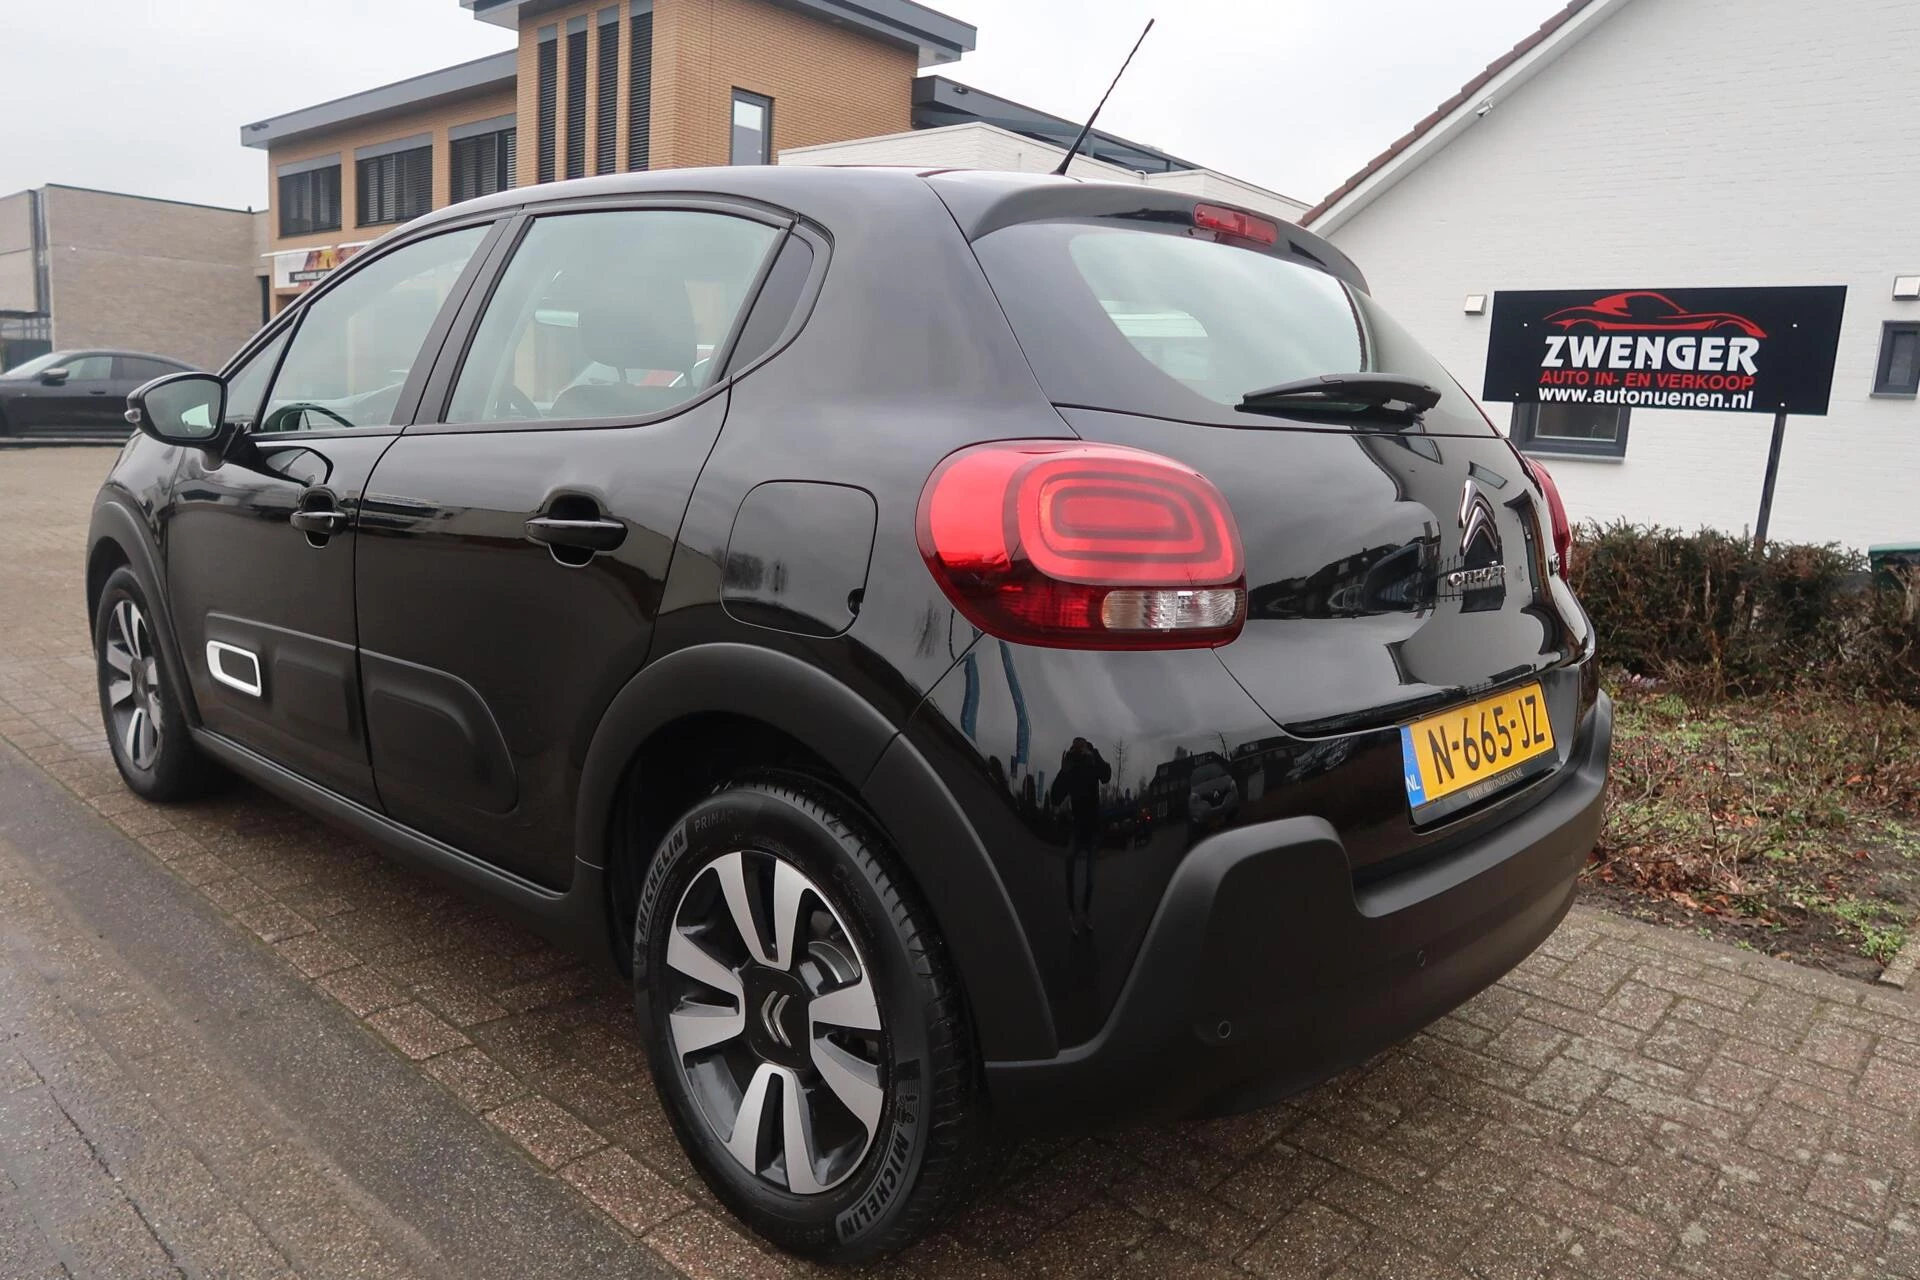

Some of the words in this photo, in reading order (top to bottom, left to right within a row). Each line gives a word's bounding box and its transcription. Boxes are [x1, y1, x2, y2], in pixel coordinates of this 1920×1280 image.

[1541, 336, 1760, 376] ZWENGER
[1541, 372, 1589, 386] AUTO
[1594, 373, 1619, 386] IN-
[1625, 374, 1650, 388] EN
[1657, 373, 1756, 391] VERKOOP
[1539, 387, 1754, 409] www.autonuenen.nl
[1428, 694, 1545, 785] N-665-JZ
[1406, 776, 1421, 792] NL
[695, 808, 741, 833] PRIMAC
[638, 829, 685, 935] MICHELIN
[840, 1131, 910, 1240] MICHELIN
